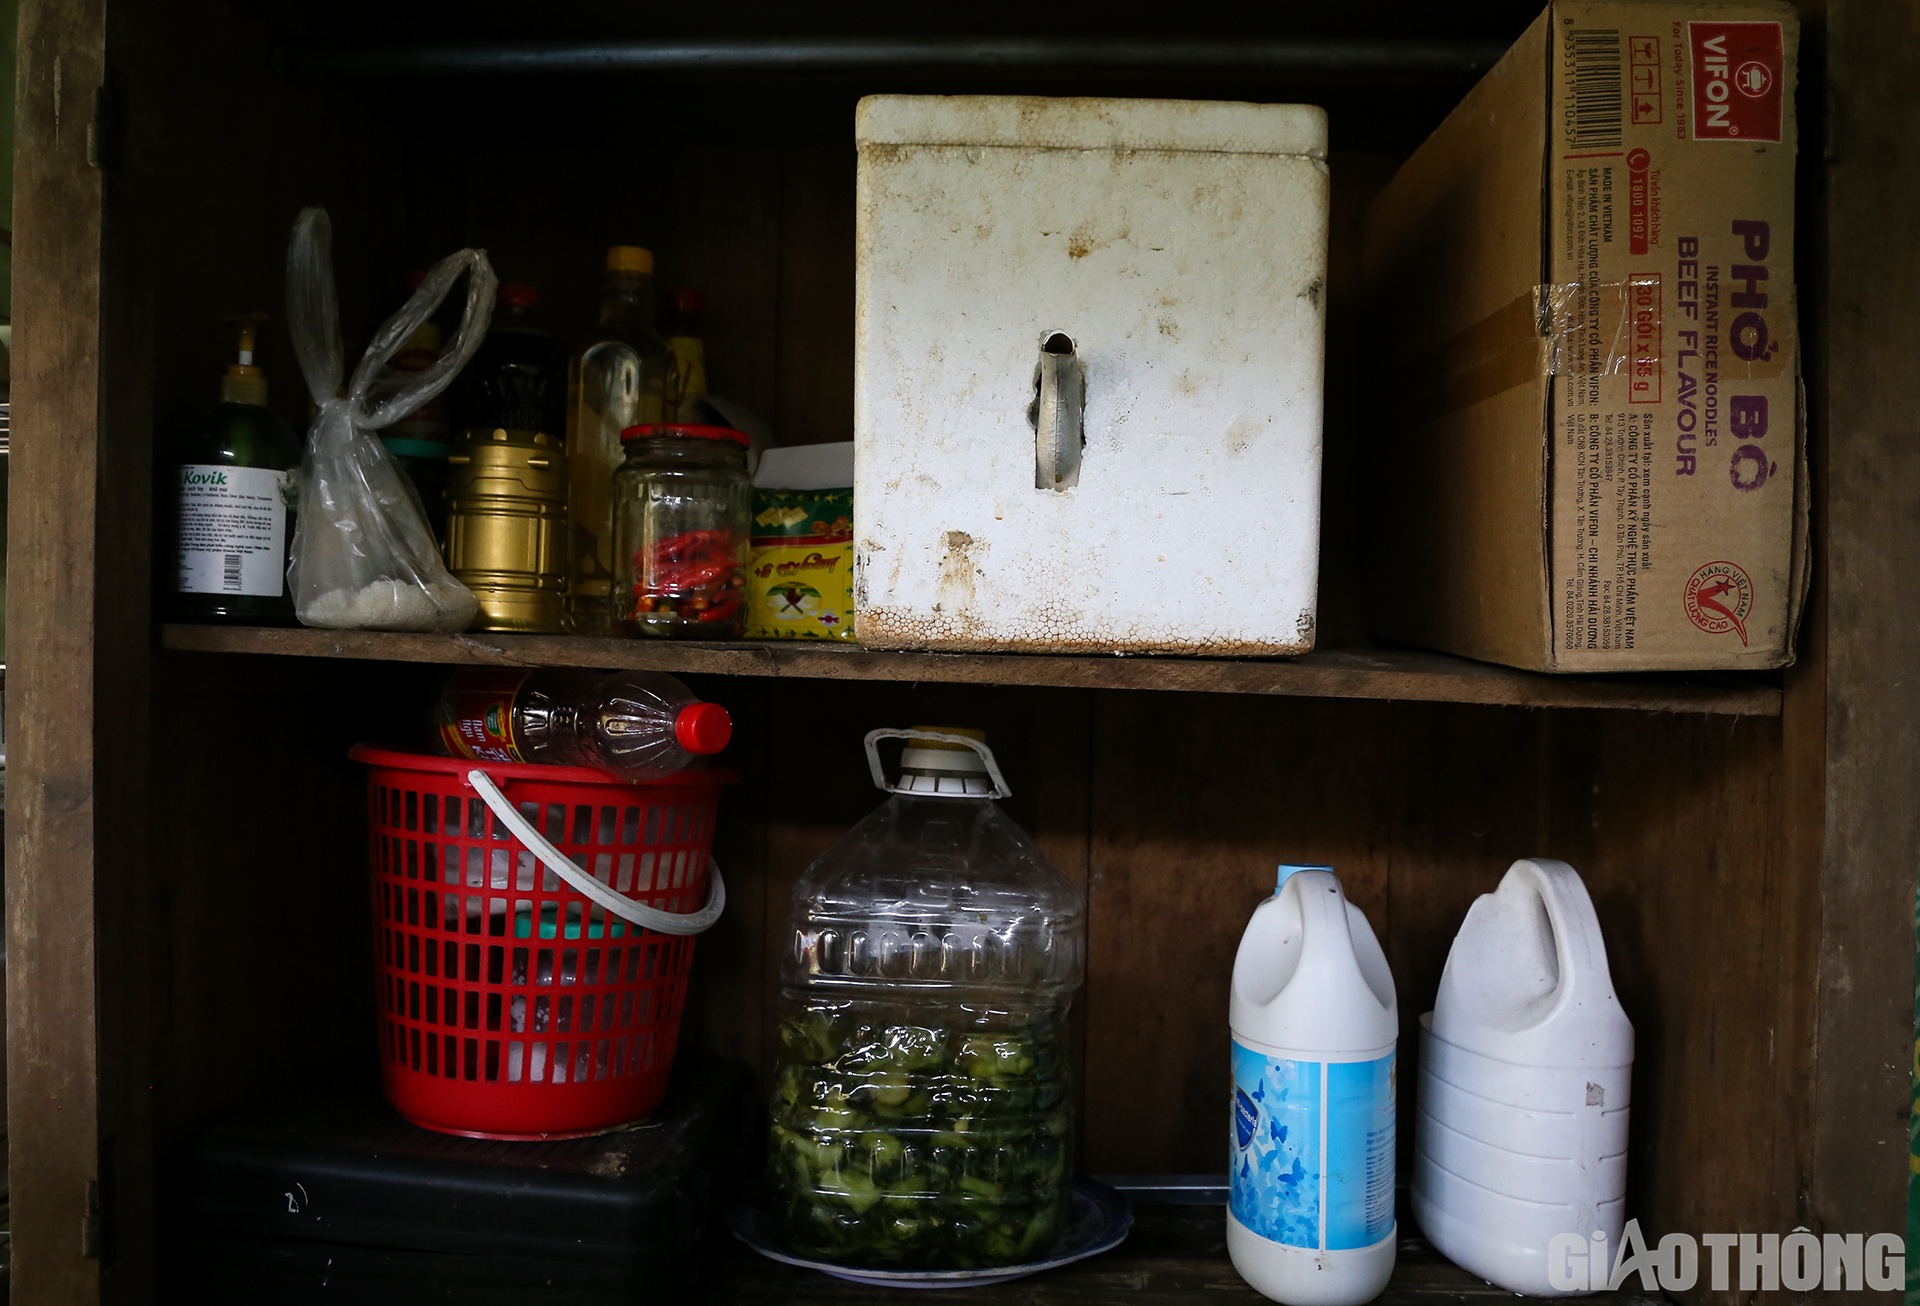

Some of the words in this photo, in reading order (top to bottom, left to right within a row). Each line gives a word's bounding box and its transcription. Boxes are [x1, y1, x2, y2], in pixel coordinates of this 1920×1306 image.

[1672, 22, 1682, 38] For
[1564, 35, 1576, 84] 935311
[1674, 43, 1684, 75] Today
[1704, 35, 1729, 126] VIFON
[1676, 80, 1685, 109] Since
[1565, 95, 1576, 144] 110457
[1677, 114, 1686, 140] 1963
[1589, 168, 1600, 185] SẢN
[1603, 168, 1612, 191] MADE
[1650, 170, 1660, 179] Tư
[1603, 194, 1612, 202] IN
[1632, 178, 1644, 206] 1800
[1650, 180, 1662, 196] vấn
[1589, 188, 1602, 212] PHẨM
[1650, 198, 1661, 222] khách
[1589, 215, 1602, 237] CHẤT
[1603, 205, 1612, 242] VIETNAM
[1632, 212, 1644, 240] 1097
[1650, 224, 1661, 244] hàng
[1586, 240, 1598, 268] LƯỢNG
[1589, 270, 1600, 288] CỦA
[1678, 236, 1698, 320] BEEF
[1637, 286, 1652, 306] 30
[1706, 266, 1718, 331] INSTANT
[1730, 220, 1779, 362] PHỞ
[1589, 290, 1600, 316] CÔNG
[1589, 319, 1599, 329] TY
[1637, 310, 1656, 339] GÓI
[1589, 332, 1603, 345] CỔ
[1637, 344, 1650, 353] x
[1576, 344, 1586, 361] Long
[1589, 348, 1602, 372] PHẦN
[1706, 336, 1718, 369] RICE
[1577, 362, 1586, 374] An,
[1589, 376, 1599, 406] VIFON:
[1634, 382, 1650, 391] g
[1676, 330, 1698, 476] FLAVOUR
[1705, 372, 1718, 446] NOODLES
[1589, 414, 1598, 422] B:
[1643, 414, 1652, 430] Sản
[1589, 425, 1601, 450] CÔNG
[1628, 425, 1640, 450] CÔNG
[1730, 395, 1778, 492] BÒ
[1589, 452, 1599, 464] TY
[1628, 452, 1638, 464] TY
[1589, 467, 1603, 479] CỔ
[1628, 467, 1641, 479] CỔ
[1643, 468, 1651, 486] xem
[1589, 482, 1602, 507] PHẦN
[1628, 482, 1641, 507] PHẦN
[1589, 510, 1598, 536] VIFON
[1628, 510, 1640, 522] KỸ
[1640, 512, 1652, 532] ngày
[1626, 524, 1639, 549] NGHỆ
[1642, 534, 1651, 550] sản
[1589, 548, 1598, 563] CHI
[1625, 552, 1637, 576] THỰC
[1588, 566, 1600, 597] NHÁNH
[1626, 578, 1639, 604] PHẨM
[1732, 571, 1748, 590] VIỆT
[1588, 600, 1600, 615] HẢI
[1624, 607, 1637, 626] VIỆT
[1736, 594, 1748, 617] NAM
[1588, 618, 1597, 650] DƯƠNG
[1708, 621, 1728, 630] CAO
[1614, 634, 1622, 649] Nam
[1625, 629, 1634, 649] NAM
